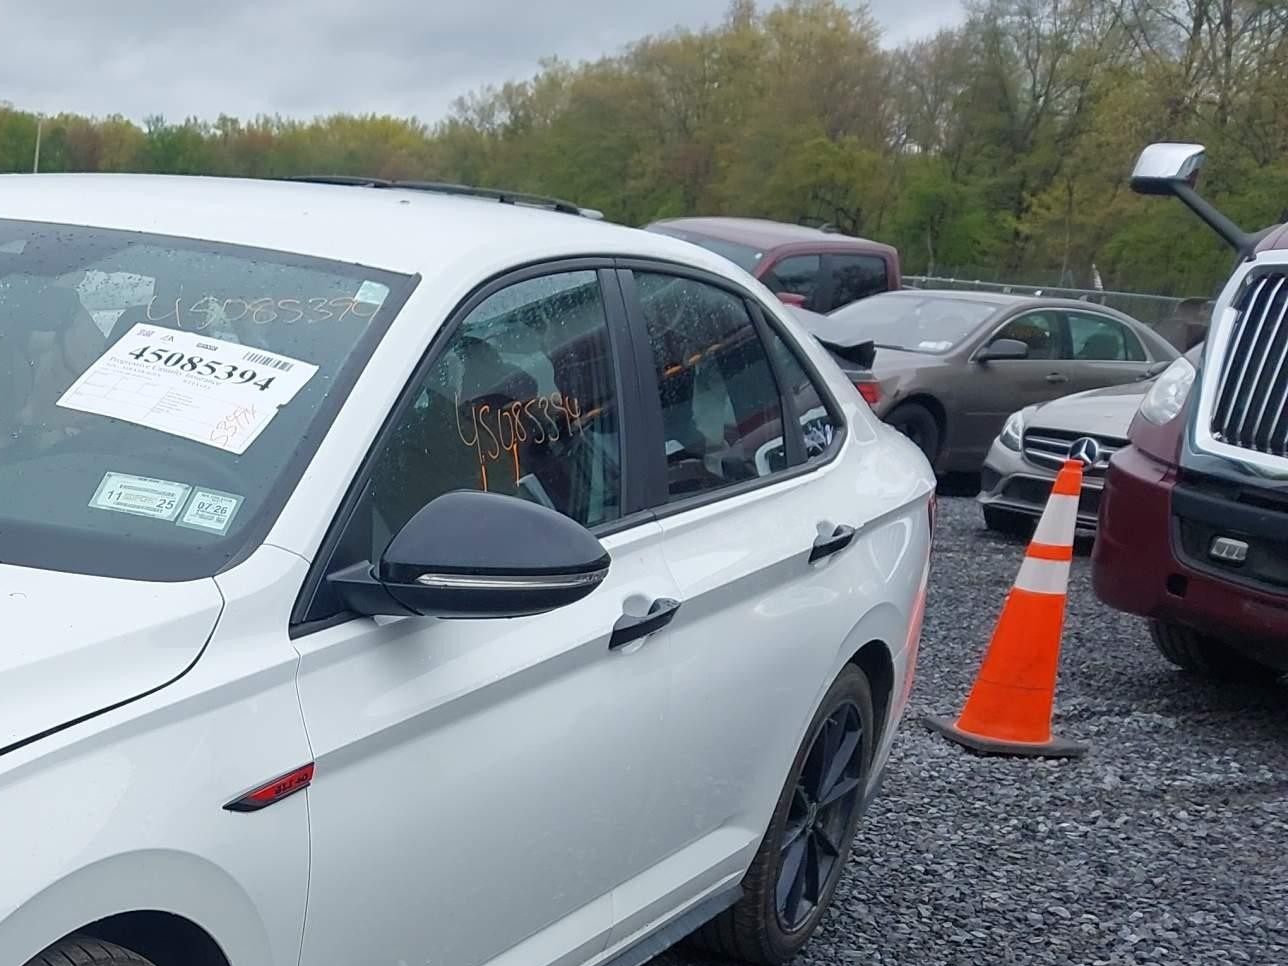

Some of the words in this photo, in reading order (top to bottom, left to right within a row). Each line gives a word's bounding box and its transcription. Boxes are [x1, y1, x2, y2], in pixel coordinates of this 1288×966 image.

[128, 345, 276, 391] 45085394
[107, 490, 123, 501] 11
[155, 498, 176, 510] 25
